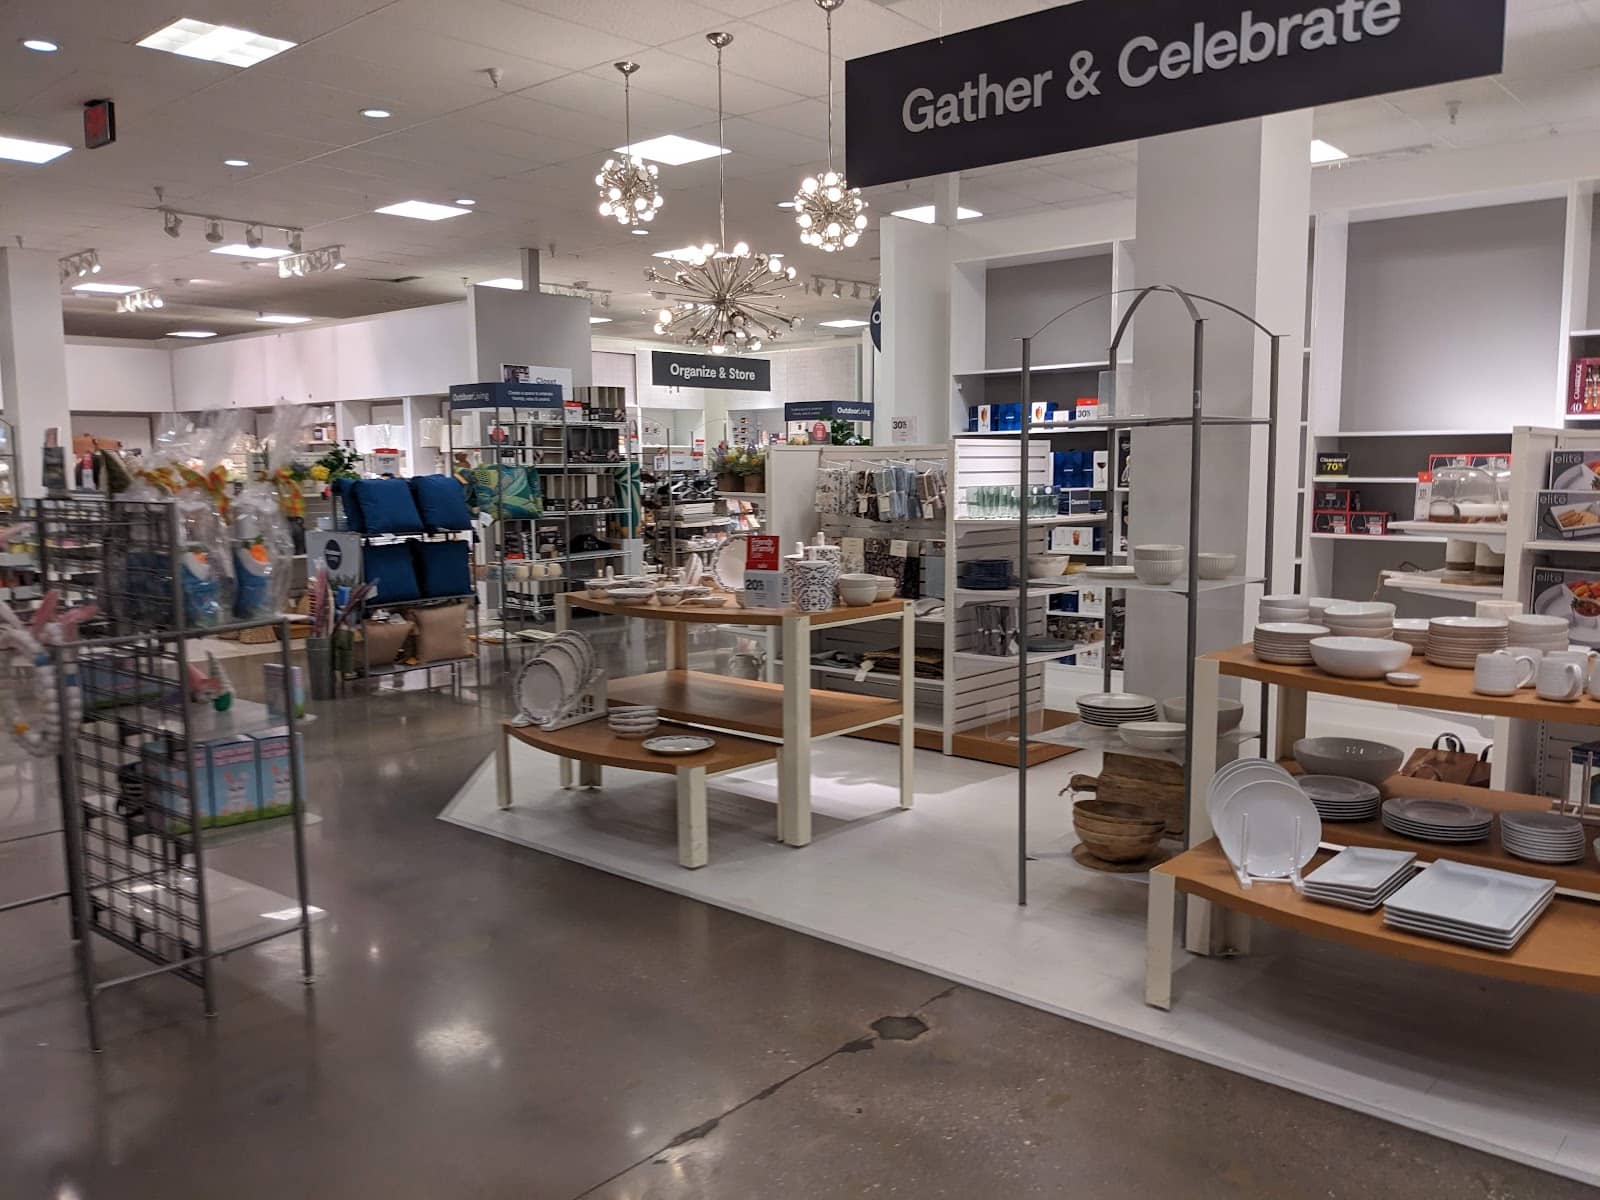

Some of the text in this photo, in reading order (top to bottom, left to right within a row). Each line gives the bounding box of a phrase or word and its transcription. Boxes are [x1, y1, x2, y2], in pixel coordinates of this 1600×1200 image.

[902, 0, 1401, 133] Gather & Celebrate
[670, 363, 756, 380] Organize & Store
